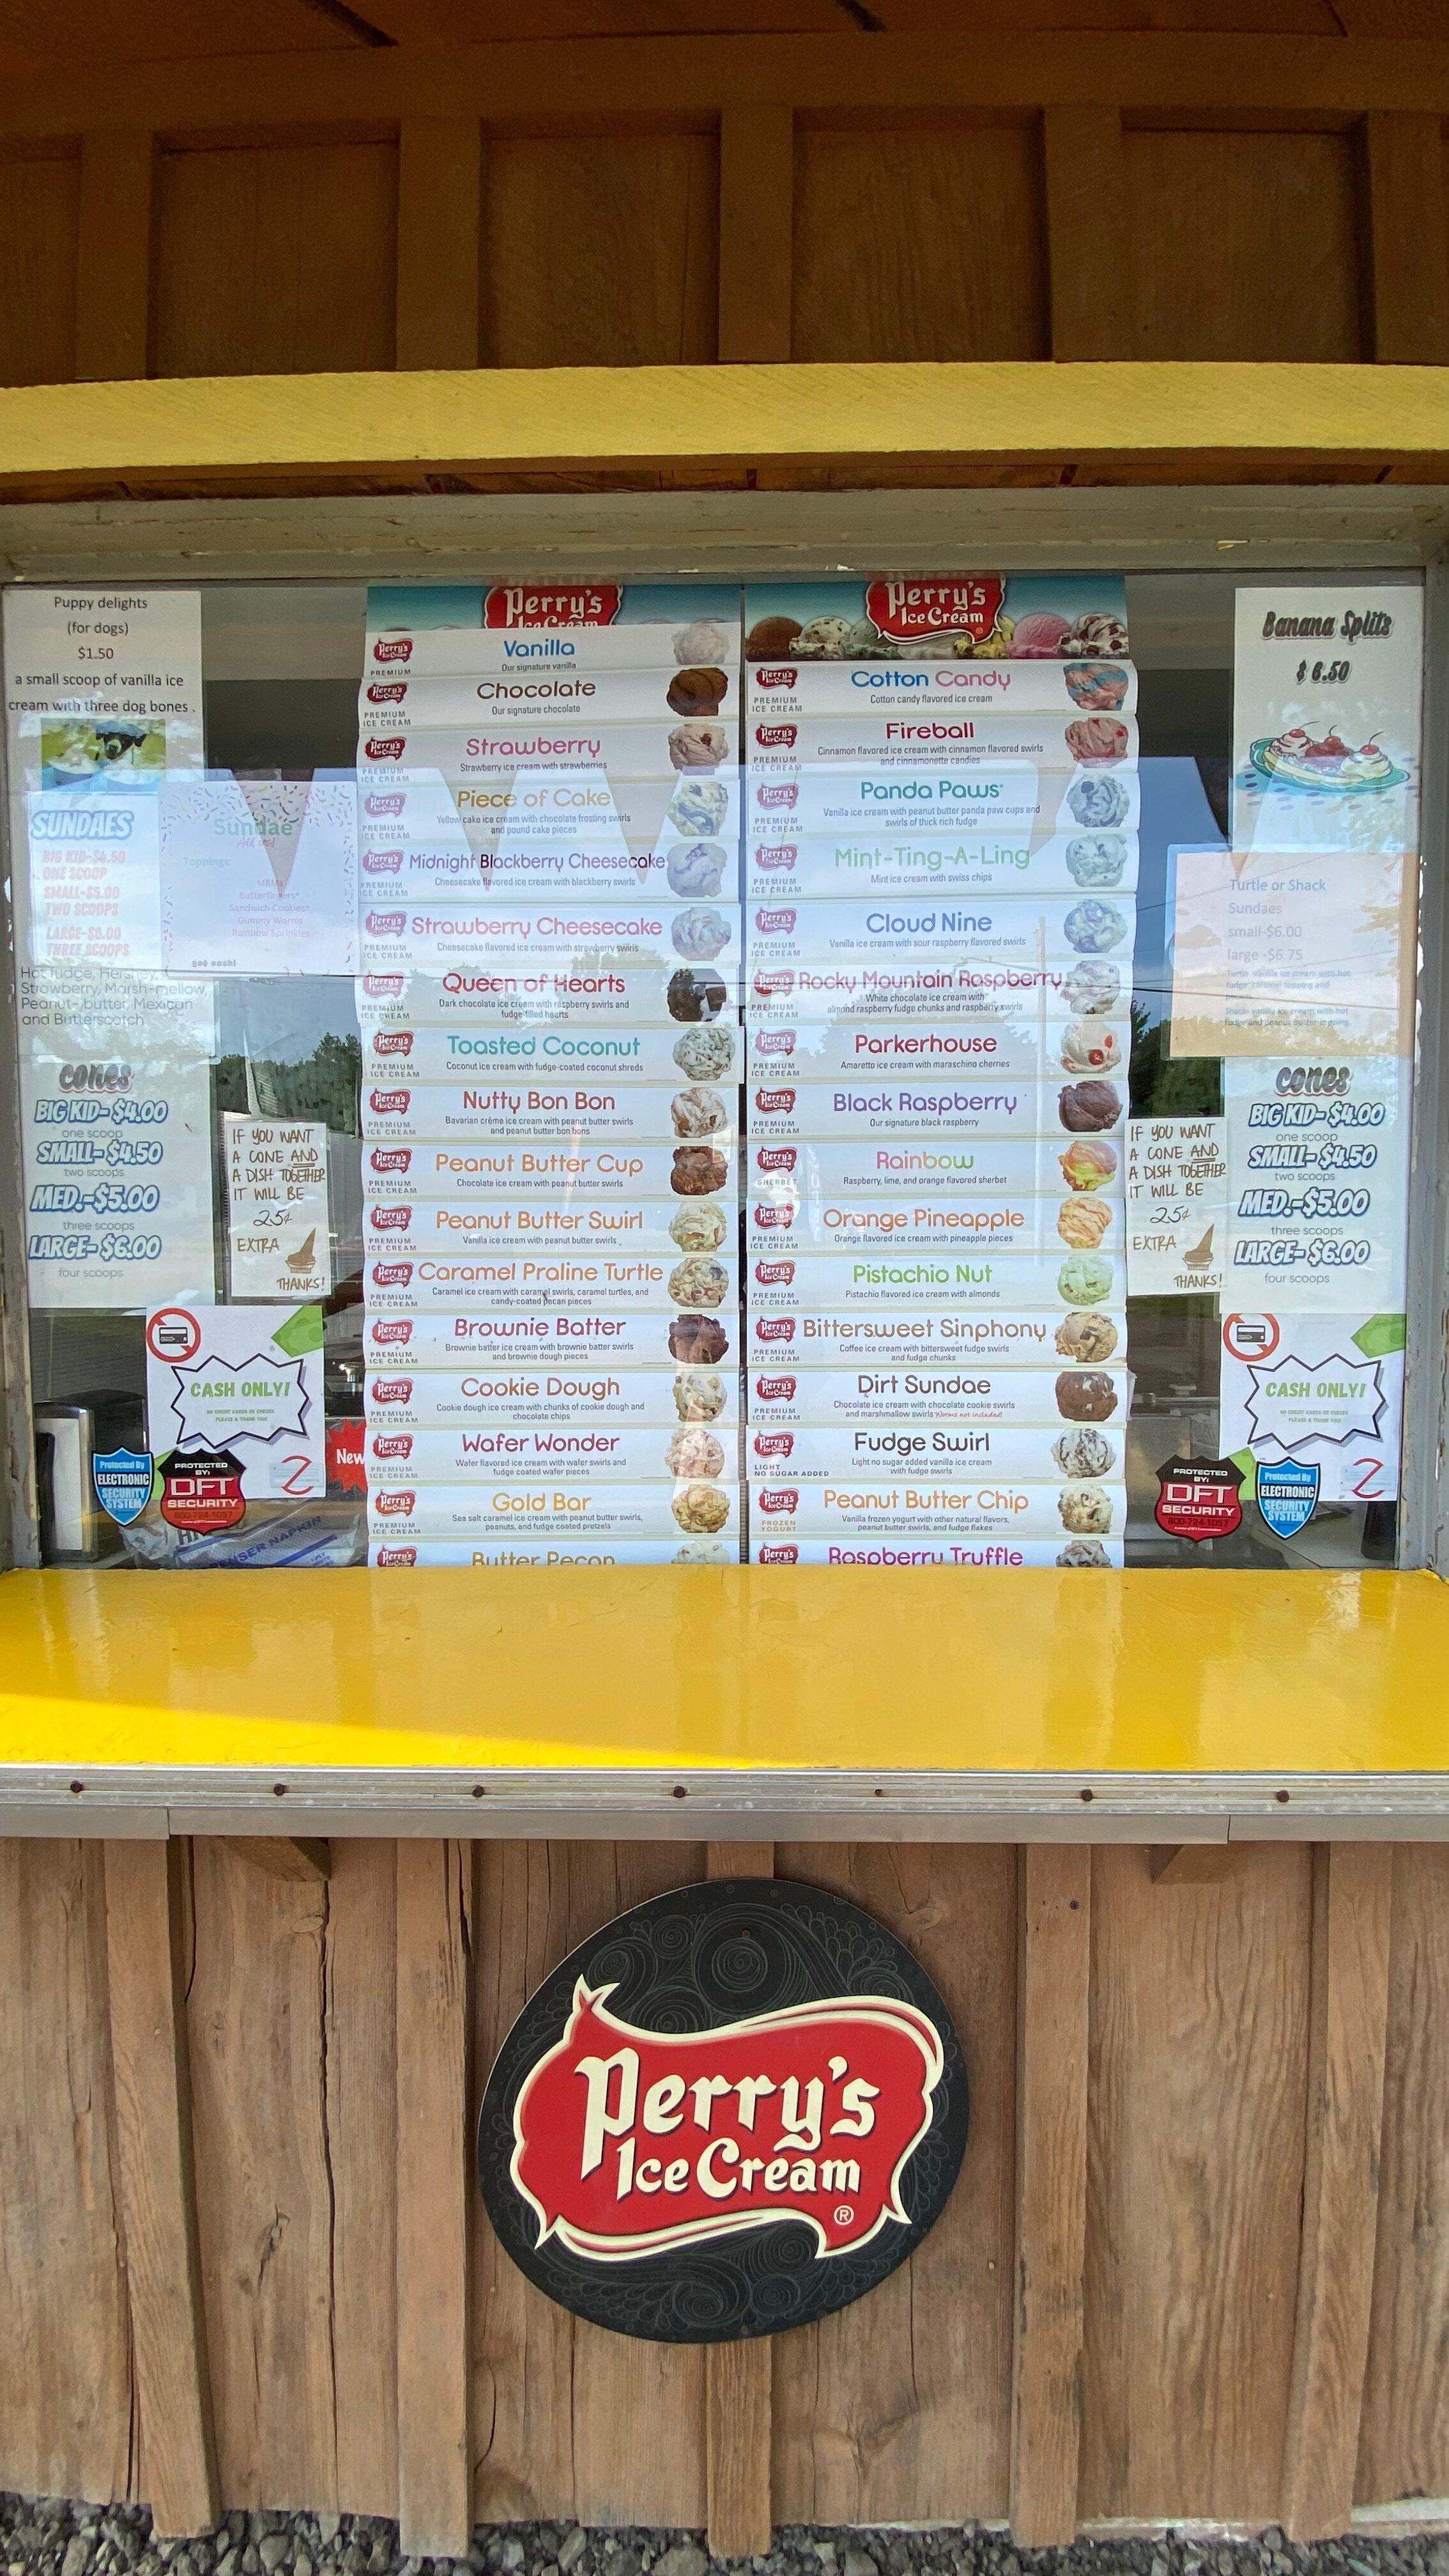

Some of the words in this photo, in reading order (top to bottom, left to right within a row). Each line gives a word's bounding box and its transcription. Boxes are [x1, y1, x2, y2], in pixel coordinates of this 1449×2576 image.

[55, 597, 94, 610] Puppy
[98, 597, 148, 611] delights
[503, 588, 603, 628] Perry's
[884, 581, 986, 618] Perry's
[902, 608, 926, 625] Ice
[927, 607, 983, 625] Cream
[68, 622, 90, 635] (for
[95, 622, 128, 636] dogs)
[1261, 611, 1335, 640] Banana
[1340, 610, 1394, 645] Splits
[79, 647, 113, 660] $1.50
[504, 639, 574, 657] Vanilla
[15, 676, 22, 684] a
[27, 673, 59, 684] small
[63, 677, 100, 687] scoop
[105, 673, 117, 685] of
[121, 674, 161, 686] vanilla
[166, 674, 183, 686] ice
[852, 671, 928, 687] Cotton
[935, 671, 1010, 691] Candy
[1297, 660, 1307, 684] $
[1312, 661, 1349, 684] 6.50
[477, 680, 595, 699] Chocolate
[9, 702, 48, 710] cream
[52, 698, 80, 711] with
[85, 700, 118, 712] three
[123, 700, 146, 714] dog
[150, 700, 188, 712] bones
[871, 695, 894, 704] Cotton
[898, 695, 920, 705] candy
[923, 694, 953, 703] flavored
[491, 707, 505, 715] Our
[507, 707, 541, 716] signature
[544, 704, 580, 713] chocolate
[381, 718, 410, 726] CREAM
[887, 723, 974, 739] Fireball
[466, 737, 600, 758] Strawberry
[458, 790, 518, 808] Piece
[523, 789, 548, 807] of
[553, 788, 613, 806] Cake
[861, 781, 932, 799] Panda
[940, 781, 1000, 798] Paws
[33, 809, 135, 840] SUNDAES
[1230, 877, 1268, 891] Turtle
[1271, 882, 1285, 891] or
[1288, 878, 1326, 891] Shack
[1229, 902, 1282, 915] Sundaes
[412, 917, 530, 939] Strawberry
[537, 917, 663, 935] Cheesecake
[866, 913, 935, 933] Cloud
[942, 912, 992, 931] Nine
[1229, 924, 1301, 939] small-$6.00
[447, 1036, 535, 1055] Toasted
[543, 1036, 640, 1056] Coconut
[856, 1034, 997, 1053] Parkerhouse
[59, 1064, 134, 1094] cones
[1275, 1067, 1353, 1097] cones
[34, 1100, 68, 1124] BIG
[69, 1100, 110, 1123] KID-
[111, 1098, 168, 1125] $4.00
[464, 1091, 520, 1114] Nutty
[528, 1092, 567, 1110] Bon
[576, 1092, 615, 1110] Bon
[834, 1093, 892, 1112] Black
[900, 1092, 1016, 1116] Raspberry
[885, 1119, 919, 1128] signature
[943, 1118, 979, 1127] raspberry
[1248, 1103, 1284, 1128] BIG
[1283, 1103, 1326, 1127] KID-
[1327, 1101, 1385, 1128] $4.00
[1131, 1126, 1144, 1141] IF
[1152, 1125, 1173, 1141] YOU
[1180, 1123, 1215, 1138] WANT
[1302, 1134, 1338, 1144] scoop
[36, 1140, 105, 1165] SMALL-
[105, 1139, 163, 1167] $4.50
[877, 1151, 974, 1169] Rainbow
[1130, 1148, 1138, 1161] A
[1148, 1146, 1183, 1160] CONE
[1191, 1142, 1219, 1157] AND
[1248, 1144, 1317, 1169] SMALL-
[1318, 1142, 1377, 1170] $4.50
[436, 1154, 514, 1172] Peanut
[523, 1154, 590, 1172] Butter
[597, 1154, 643, 1177] Cup
[1130, 1166, 1138, 1179] A
[1144, 1165, 1172, 1179] DISH
[1177, 1162, 1226, 1178] TOGETHER
[1298, 1174, 1335, 1182] scoops
[1130, 1185, 1144, 1199] IT
[1151, 1184, 1178, 1197] WILL
[1186, 1182, 1203, 1196] BE
[824, 1209, 908, 1232] Orange
[915, 1208, 1024, 1231] Pineapple
[1150, 1206, 1190, 1223] 25¢
[1271, 1226, 1300, 1234] three
[1303, 1227, 1343, 1237] scoops
[28, 1235, 98, 1261] LARGE-
[100, 1233, 162, 1262] $6.00
[1133, 1235, 1176, 1252] EXTRA
[1234, 1240, 1307, 1266] LARGE-
[1307, 1238, 1370, 1267] $6.00
[418, 1262, 516, 1280] Caramel
[523, 1262, 598, 1280] Praline
[604, 1263, 663, 1281] Turtle
[854, 1263, 949, 1283] Pistachio
[956, 1265, 992, 1283] Nut
[1265, 1273, 1286, 1283] four
[1289, 1275, 1330, 1285] scoops
[1174, 1273, 1222, 1291] THANKS!
[455, 1317, 549, 1337] Brownie
[557, 1318, 626, 1335] Batter
[804, 1319, 933, 1337] Bittersweet
[940, 1319, 1046, 1342] Sinphony
[191, 1383, 234, 1397] CASH
[241, 1381, 290, 1397] ONLY!
[461, 1377, 539, 1397] Cookie
[548, 1377, 619, 1400] Dough
[859, 1374, 898, 1395] Dirt
[905, 1375, 991, 1394] Sundae
[1266, 1383, 1310, 1397] CASH
[1317, 1383, 1366, 1397] ONLY!
[463, 1434, 529, 1452] Wafer
[535, 1434, 620, 1452] Wonder
[855, 1432, 926, 1456] Fudge
[933, 1432, 989, 1451] Swirl
[170, 1478, 234, 1496] DFT
[1261, 1485, 1314, 1498] ELECTRONIC
[168, 1499, 238, 1508] SECURITY
[493, 1492, 545, 1511] Gold
[554, 1493, 592, 1511] Bar
[825, 1490, 899, 1508] Peanut
[906, 1491, 972, 1509] Butter
[977, 1490, 1029, 1514] Chip
[1264, 1500, 1309, 1511] SECURITY
[1268, 1510, 1304, 1521] SYSTEM
[574, 2048, 881, 2182] Perry's
[617, 2136, 689, 2201] Ice
[698, 2138, 861, 2200] Cream
